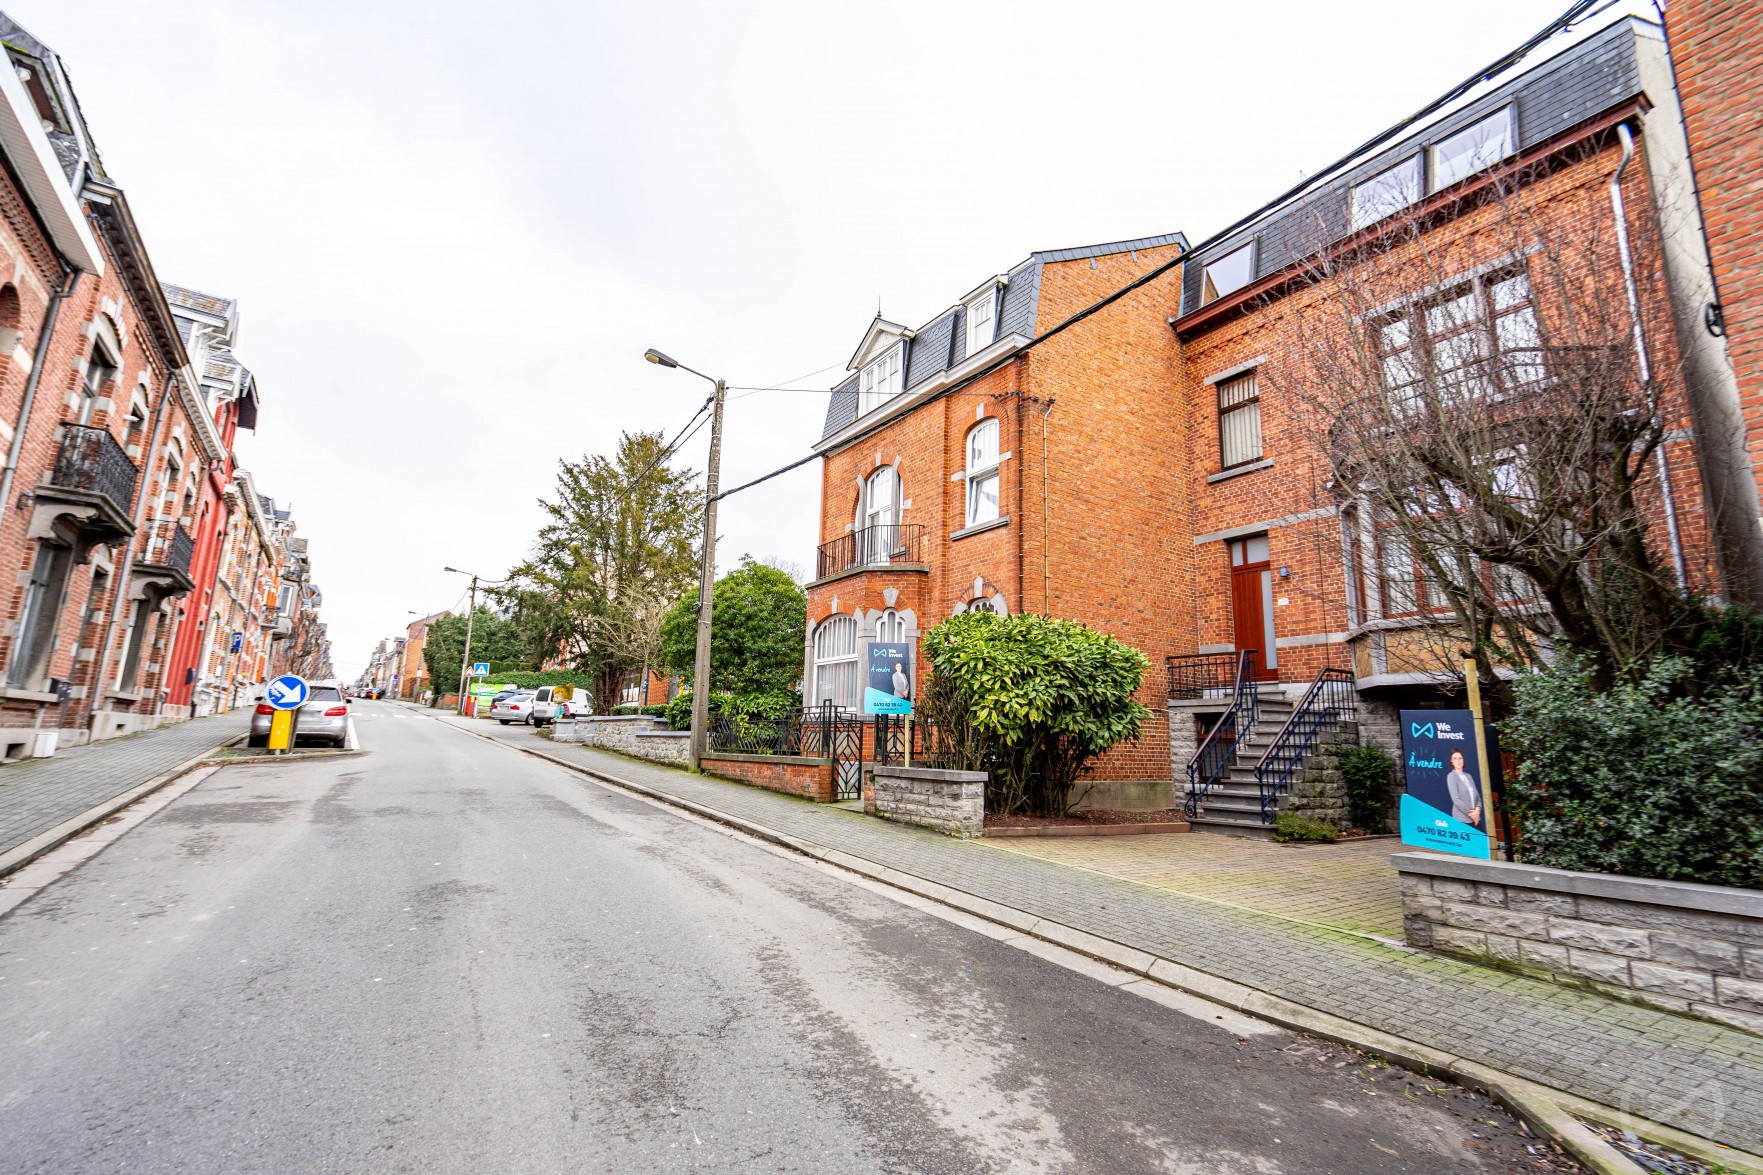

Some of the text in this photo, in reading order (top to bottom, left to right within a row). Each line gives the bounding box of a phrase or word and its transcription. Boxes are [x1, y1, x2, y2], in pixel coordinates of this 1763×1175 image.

[1436, 722, 1451, 731] We
[1437, 731, 1464, 740] Invest
[1408, 751, 1442, 768] À vendre
[1417, 826, 1436, 835] 0470
[1437, 830, 1447, 838] 82
[1448, 832, 1458, 840] 39
